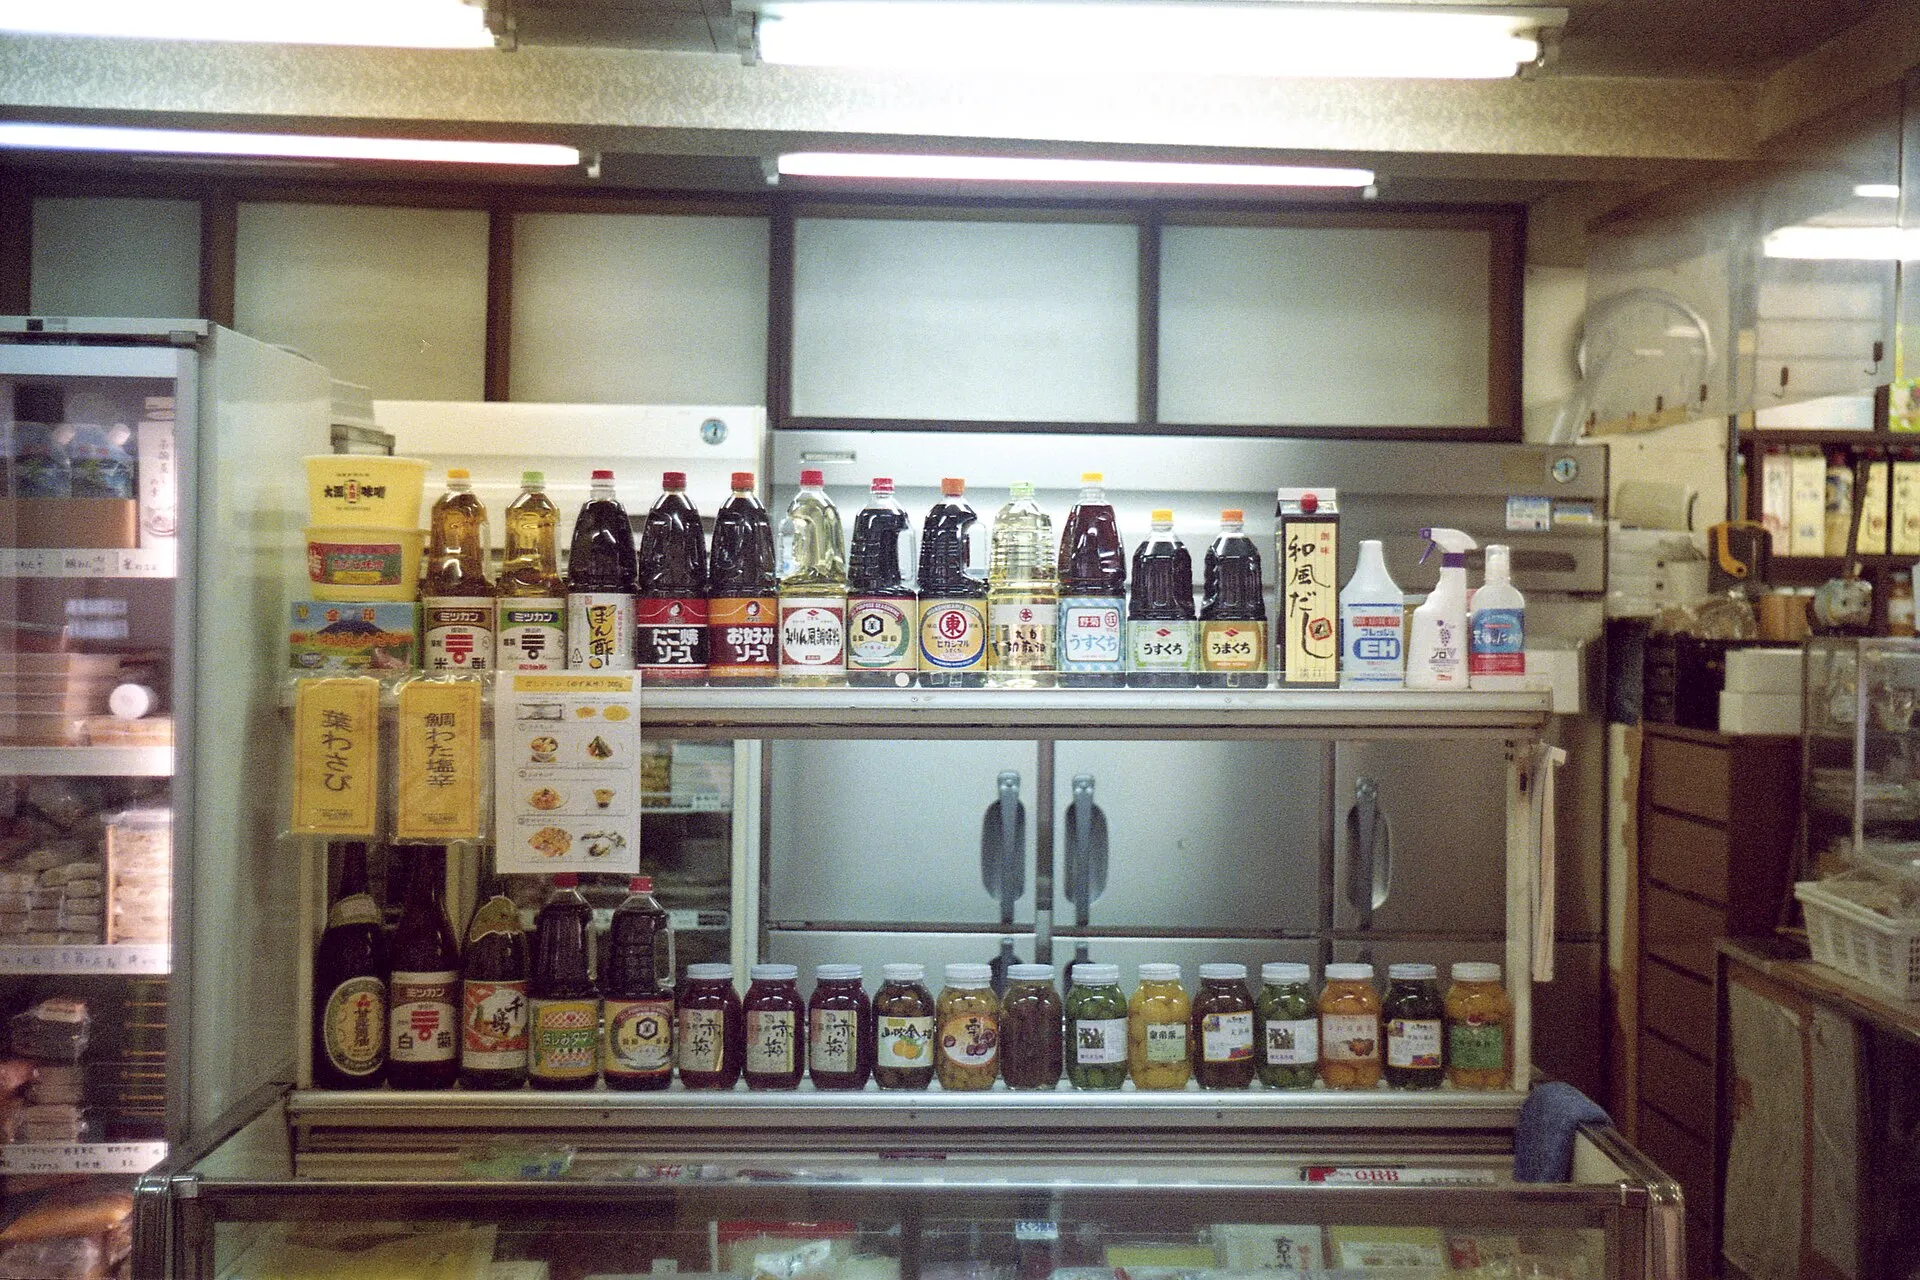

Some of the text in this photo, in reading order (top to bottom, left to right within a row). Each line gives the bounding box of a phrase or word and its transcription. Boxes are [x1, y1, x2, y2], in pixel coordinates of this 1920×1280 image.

[1288, 534, 1333, 658] 和風だし
[439, 611, 479, 622] ミツカン
[514, 612, 553, 622] ミツカン
[944, 613, 962, 636] 東
[586, 604, 616, 666] ぽん酢
[652, 628, 699, 646] たこ焼
[727, 627, 774, 645] お好み
[1361, 628, 1395, 637] フレッシュ
[937, 640, 969, 648] ヒガシマル
[1069, 634, 1117, 651] うすくち
[1143, 643, 1182, 655] うすくち
[1212, 642, 1250, 655] うまくち
[1360, 639, 1398, 658] EH
[657, 646, 694, 663] ソース
[735, 645, 769, 662] ソース
[321, 709, 353, 792] 葉わさび
[406, 987, 445, 998] ミツカン
